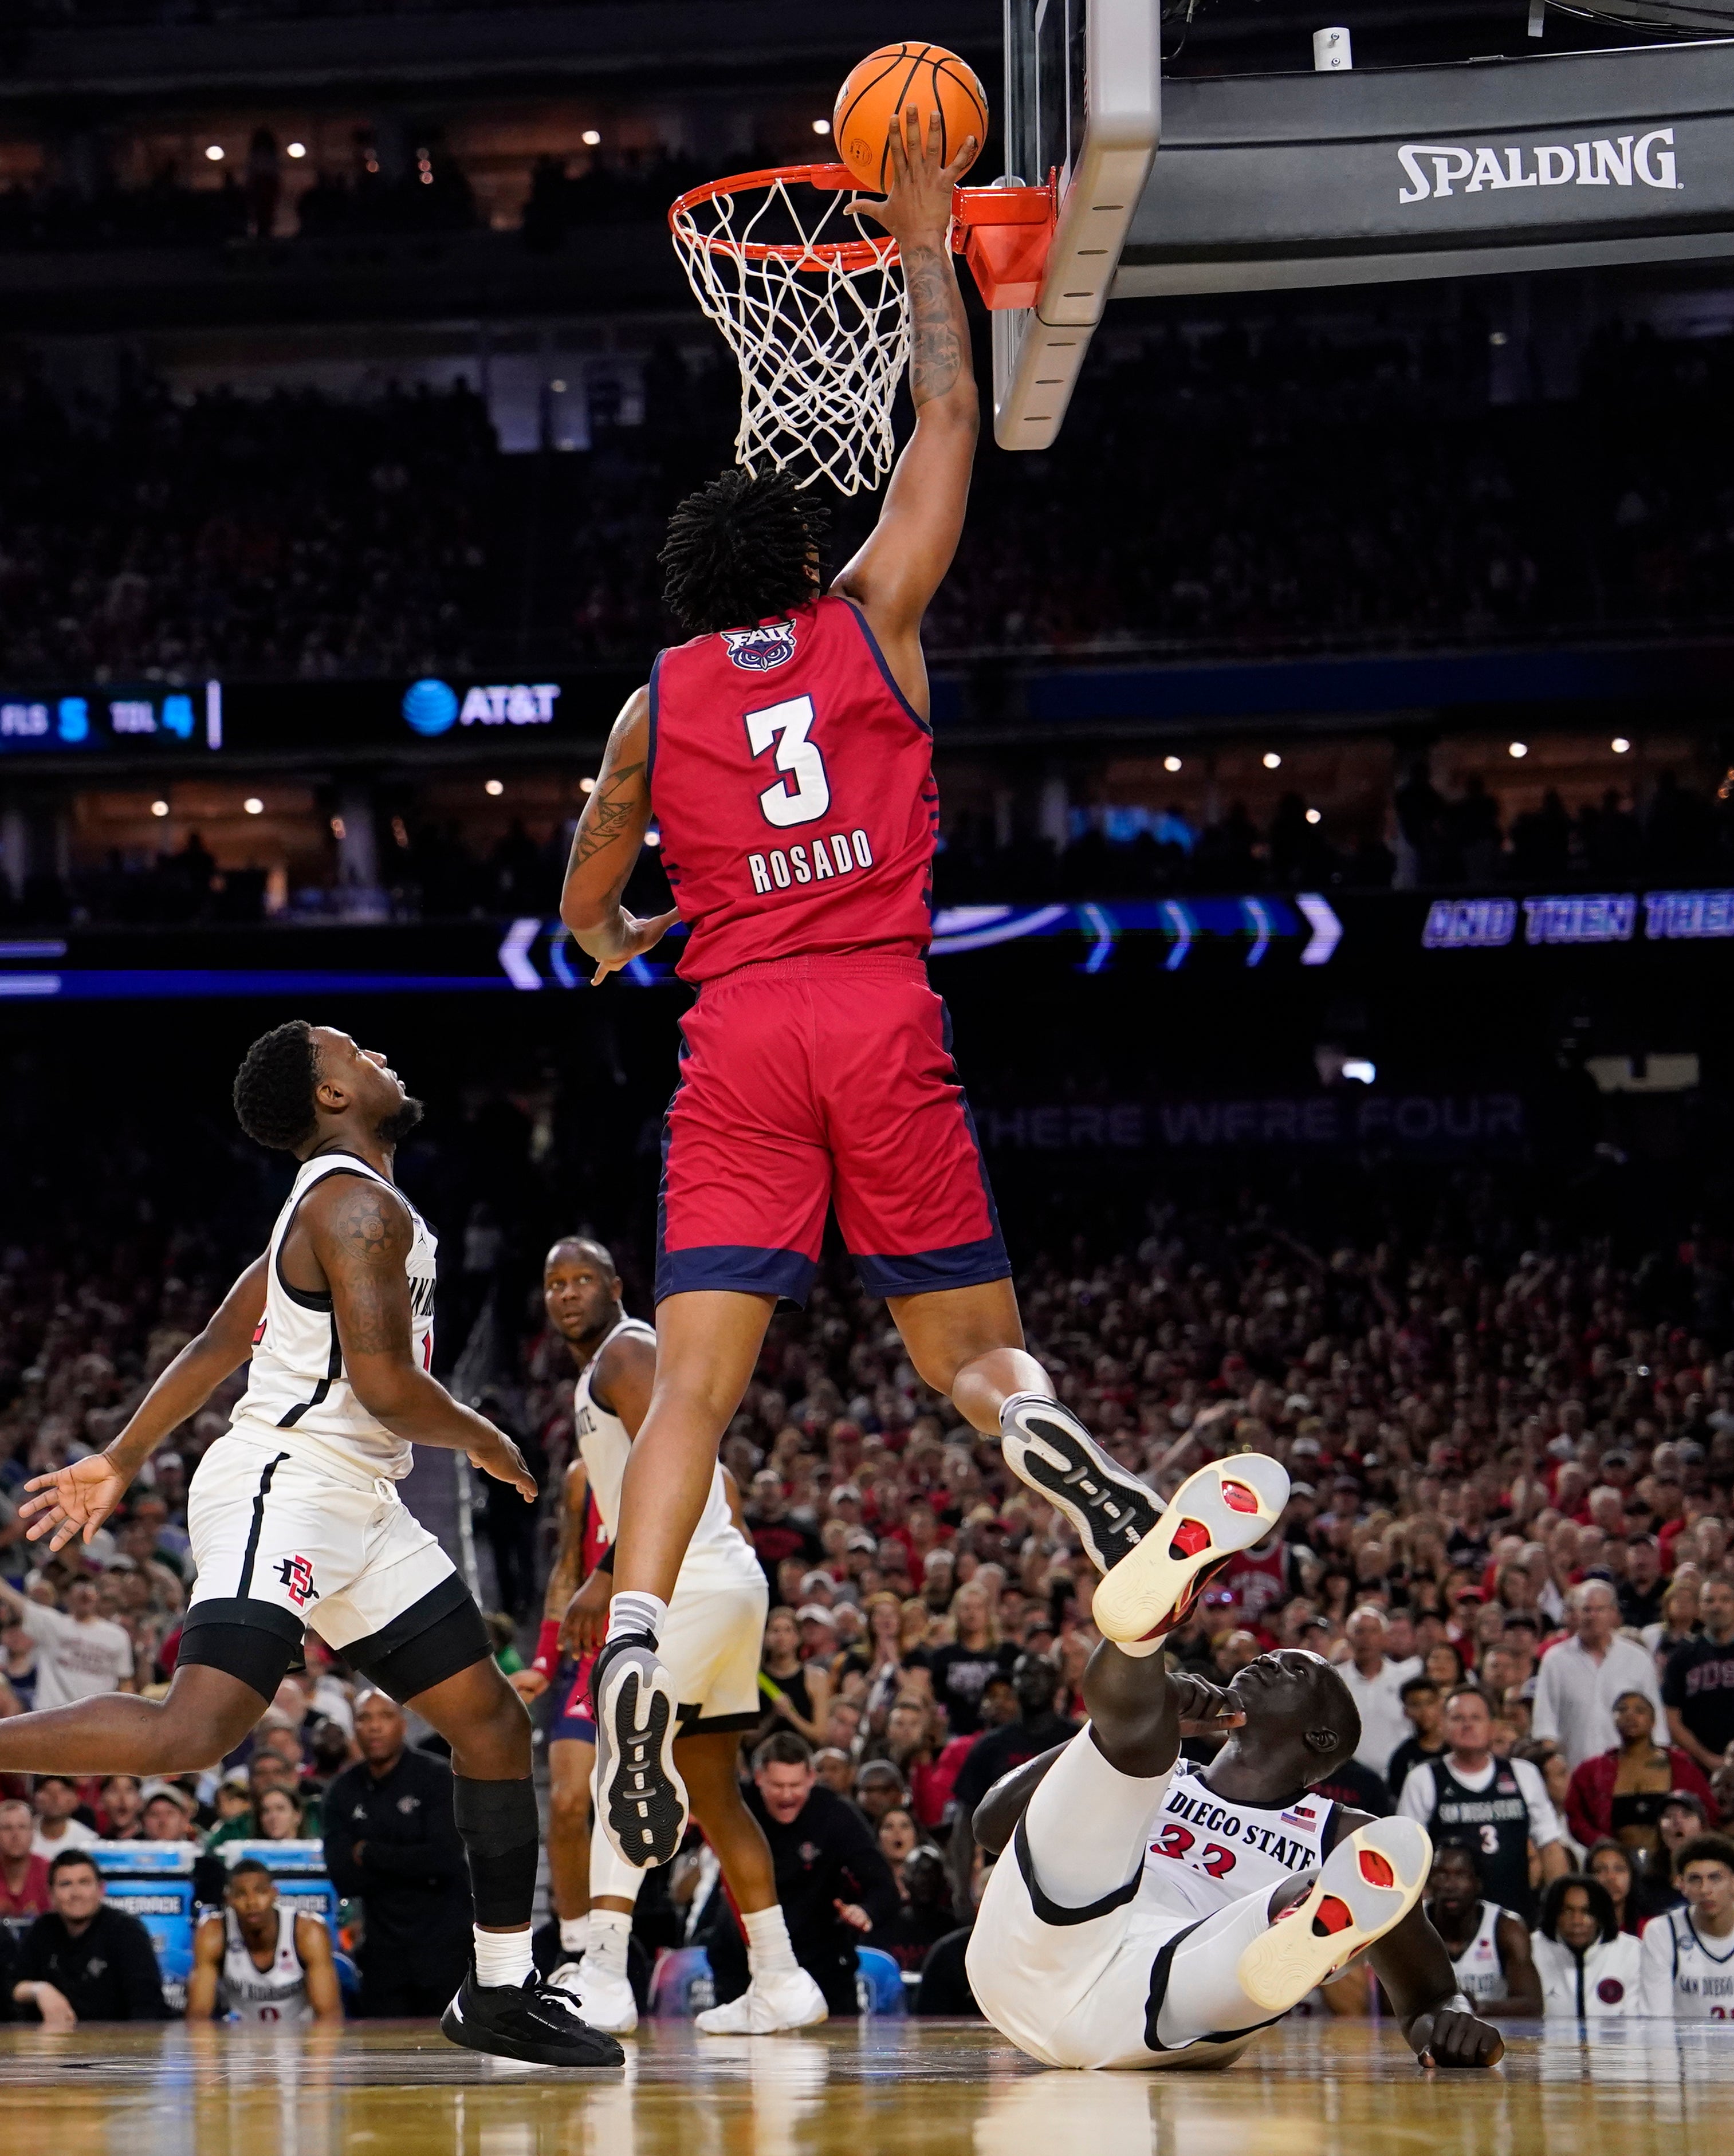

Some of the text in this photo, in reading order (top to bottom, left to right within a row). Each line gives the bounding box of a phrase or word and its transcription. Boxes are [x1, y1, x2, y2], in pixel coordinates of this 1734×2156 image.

[1397, 127, 1677, 204] SPALDING
[722, 621, 795, 652] FAU
[58, 697, 88, 742] 5
[163, 694, 194, 739] 4
[460, 683, 561, 726] AT&T
[744, 693, 831, 829] 3
[748, 829, 874, 895] ROSADO
[1165, 1791, 1316, 1872] DIEGO STATE
[1479, 1824, 1499, 1855] 3
